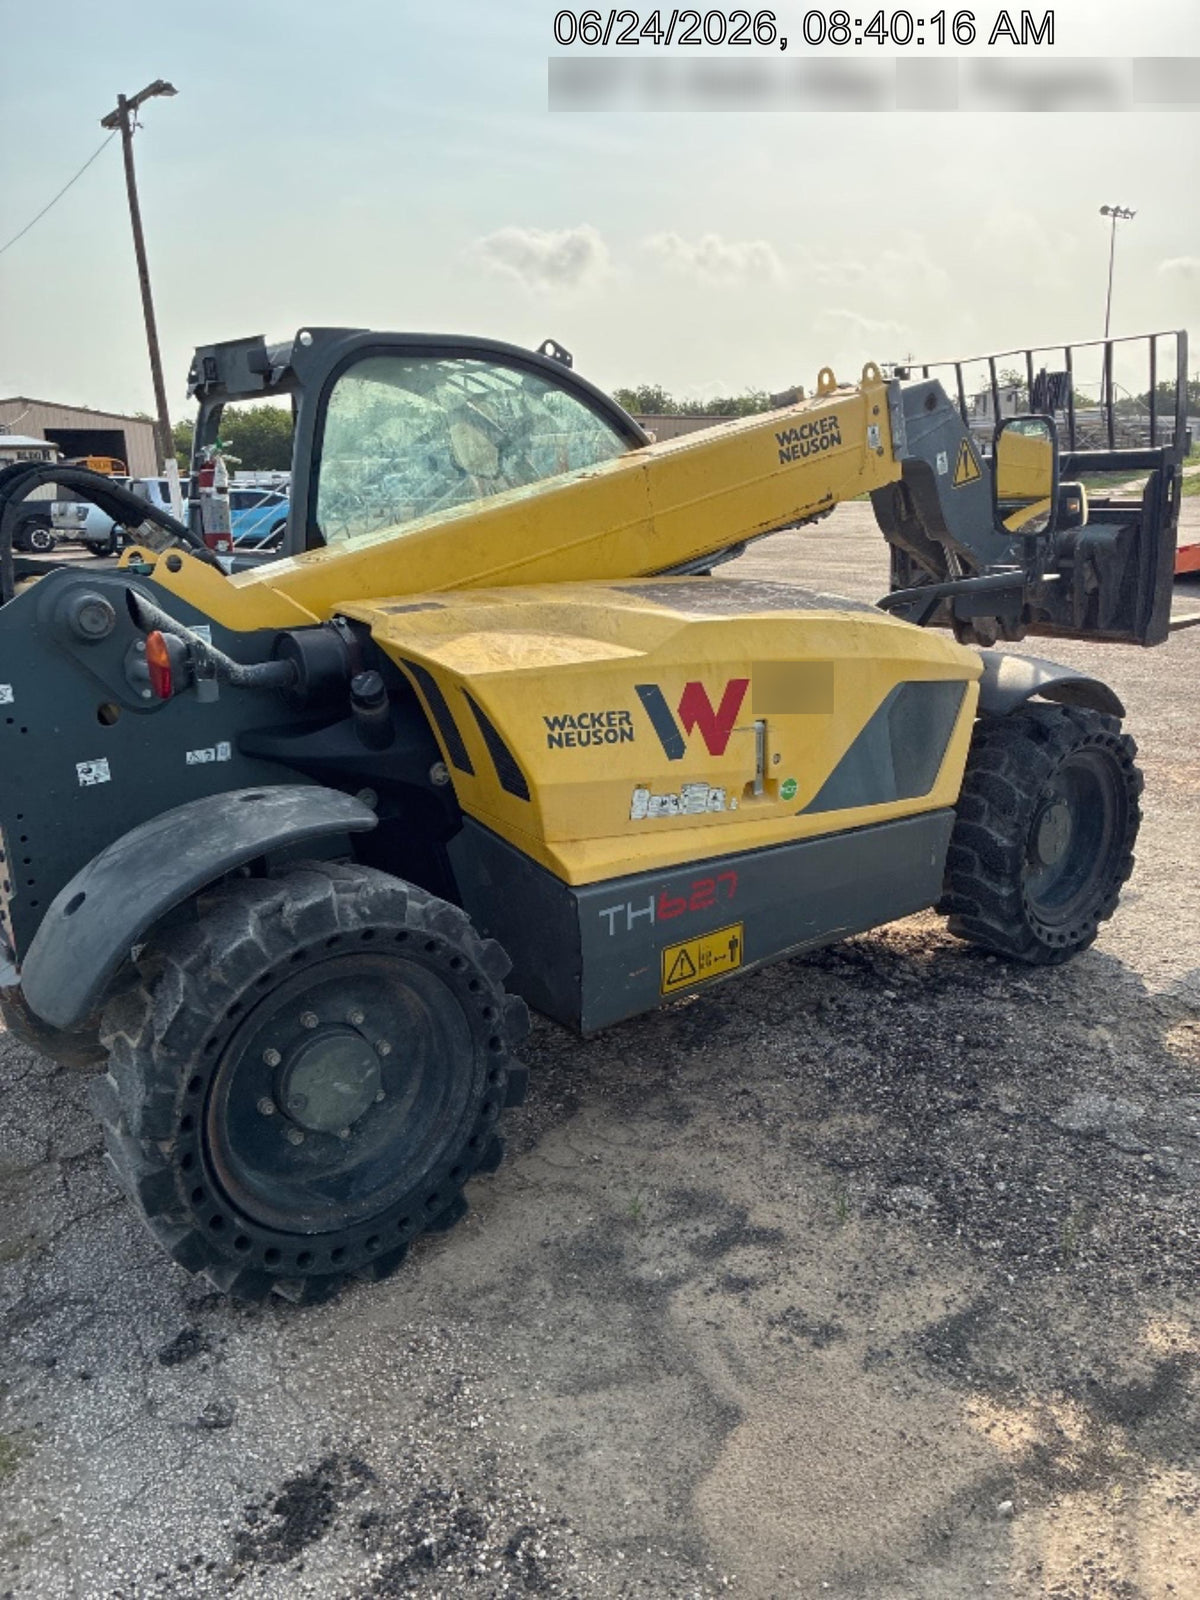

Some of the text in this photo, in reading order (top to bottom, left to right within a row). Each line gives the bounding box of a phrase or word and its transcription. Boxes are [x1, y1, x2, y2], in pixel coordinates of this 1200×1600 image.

[775, 416, 840, 446] WACKER
[779, 430, 842, 465] NEUSON
[542, 711, 633, 731] WACKER
[547, 727, 635, 749] NEUSON
[599, 870, 738, 935] TH627
